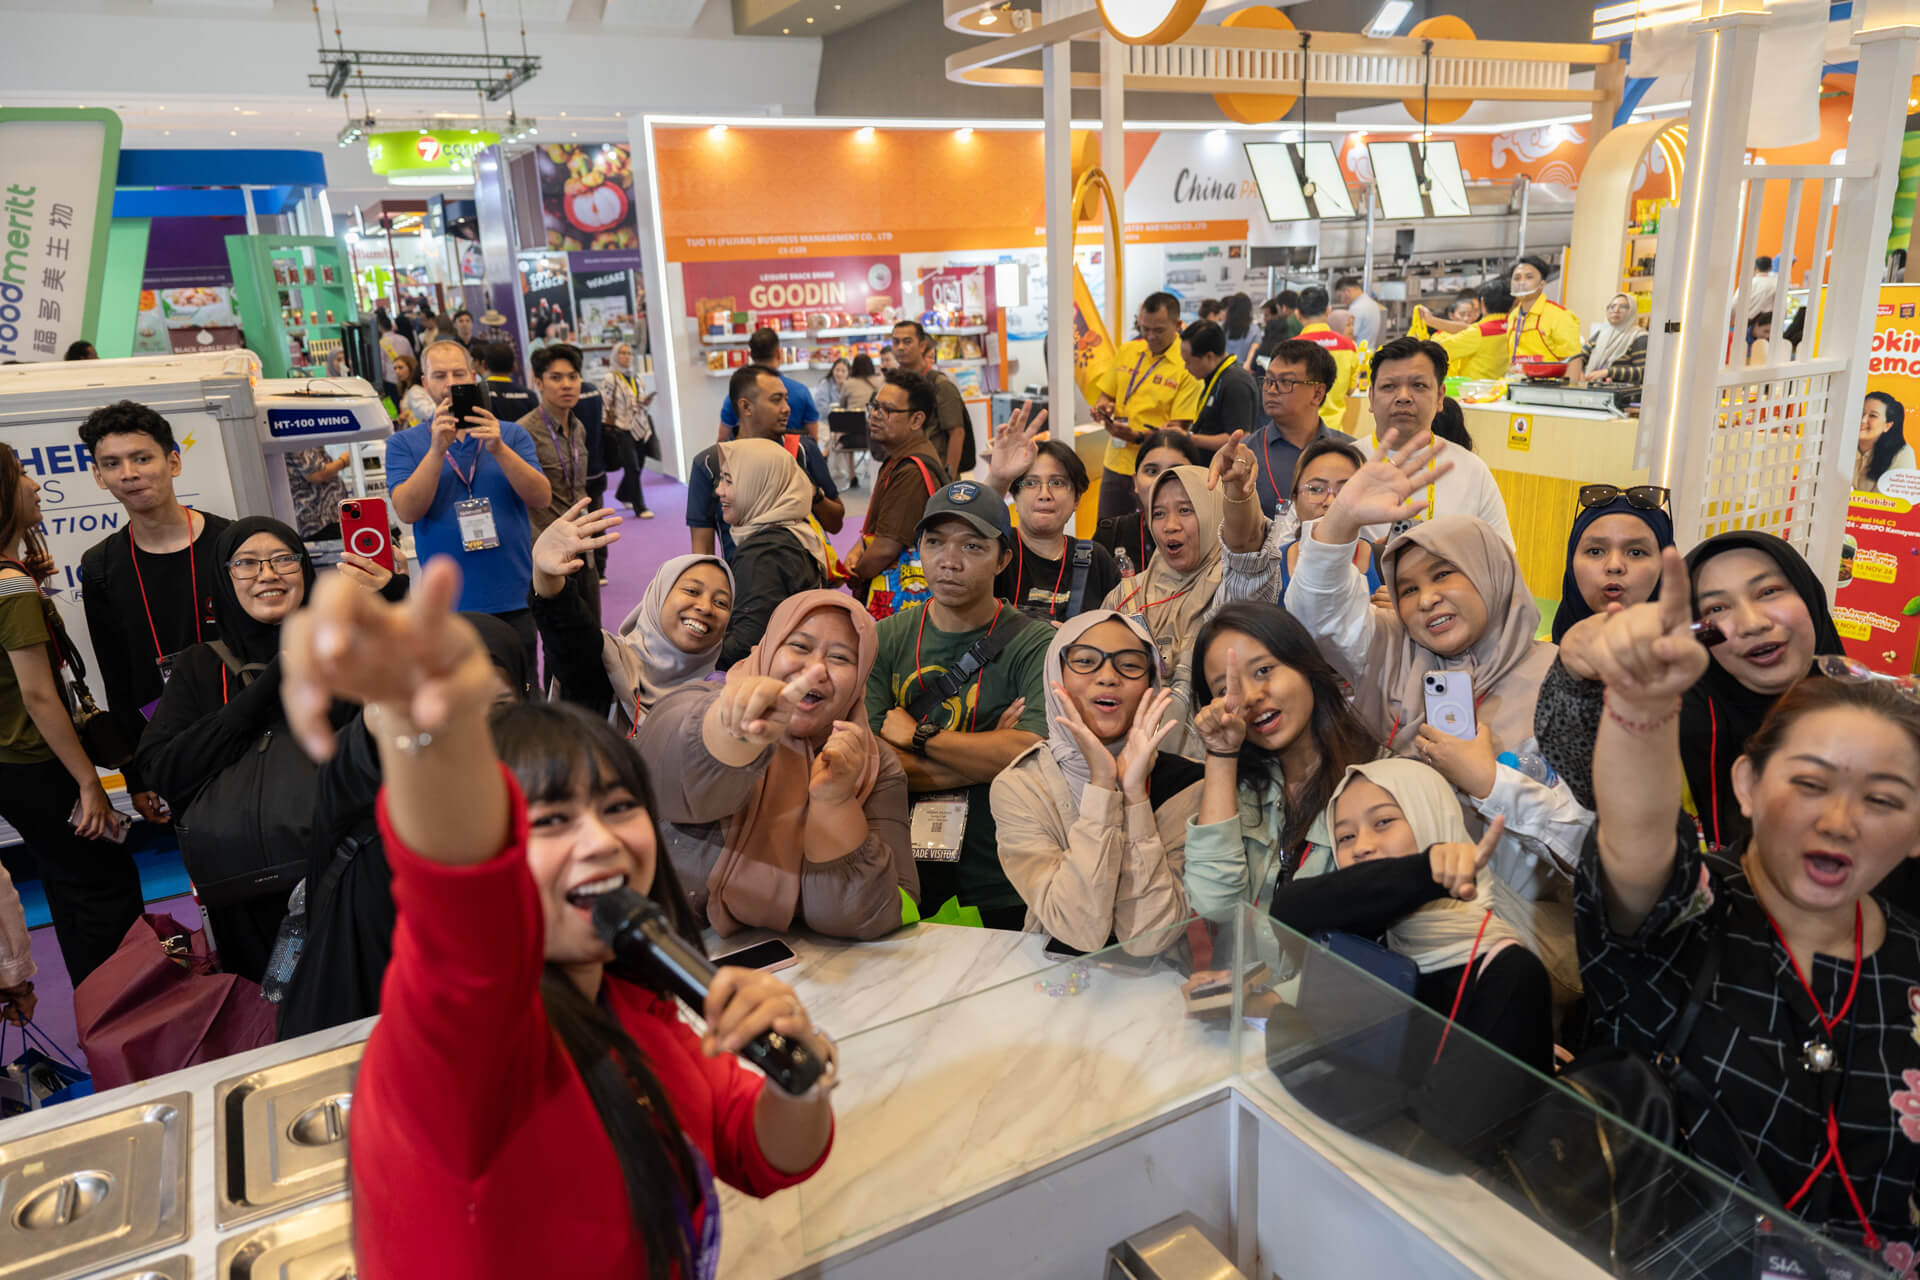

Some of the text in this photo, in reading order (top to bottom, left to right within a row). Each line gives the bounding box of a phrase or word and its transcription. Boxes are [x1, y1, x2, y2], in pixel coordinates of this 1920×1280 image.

[1174, 168, 1257, 204] China PA
[758, 235, 798, 245] BUSINESS
[799, 233, 859, 243] MANAGEMENT
[749, 281, 846, 308] GOODIN
[1869, 356, 1920, 375] emo
[274, 416, 350, 430] HT-100 WING
[35, 512, 118, 536] ATION
[912, 849, 928, 859] RADE
